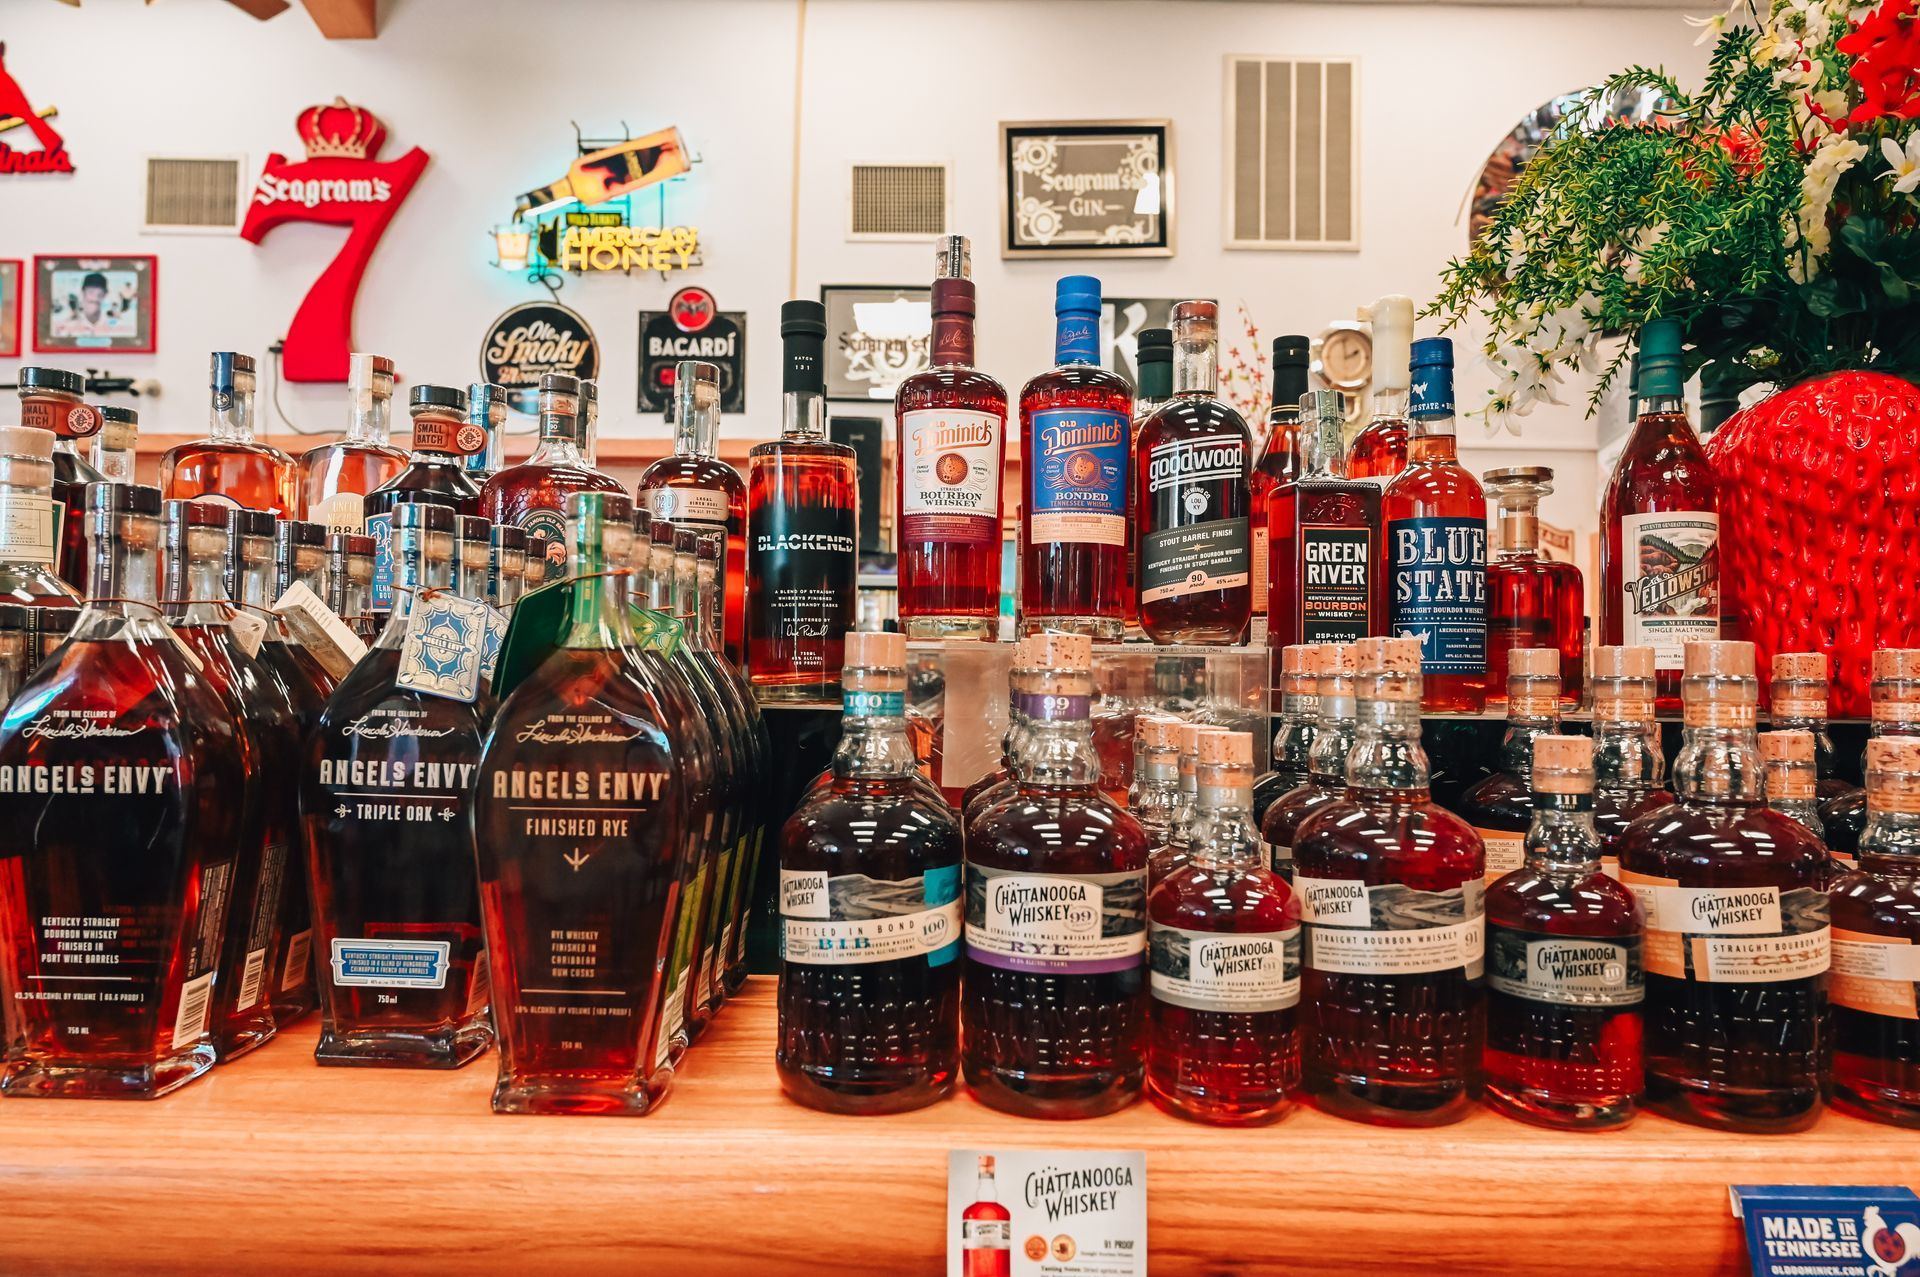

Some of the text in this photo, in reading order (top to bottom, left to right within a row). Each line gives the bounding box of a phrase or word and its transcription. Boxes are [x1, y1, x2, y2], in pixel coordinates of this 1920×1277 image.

[1041, 167, 1132, 196] Seagram's
[255, 174, 392, 207] Seagram's
[562, 226, 698, 250] AMERICAN
[240, 146, 430, 383] 7
[562, 246, 697, 271] HONEY
[487, 326, 591, 369] Smoky
[22, 404, 49, 415] SMALL
[1418, 402, 1439, 411] STATE
[417, 423, 443, 433] SMALL
[1060, 420, 1077, 428] OLD
[417, 434, 443, 444] BATCH
[1041, 419, 1122, 456] Dominick
[1149, 440, 1243, 492] goodwood
[920, 491, 982, 501] BOURBON
[1055, 492, 1109, 501] BONDED
[1181, 487, 1205, 500] BREWING
[925, 499, 977, 508] WHISKEY
[758, 533, 853, 553] BLACKENED
[1160, 528, 1233, 548] STOUT BARREL FINISH
[1305, 542, 1367, 563] GREEN
[1396, 527, 1485, 567] BLUE
[1148, 560, 1171, 570] KENTUCKY
[1172, 554, 1198, 563] STRAIGHT
[1200, 550, 1225, 559] BOURBON
[1159, 565, 1183, 574] FINISHED
[1192, 560, 1210, 568] STOUT
[1210, 556, 1233, 565] BARRELS
[1191, 574, 1203, 583] 90
[1307, 564, 1365, 585] RIVER
[1396, 570, 1485, 604] STATE
[1305, 601, 1367, 611] BOURBON
[1433, 606, 1463, 614] BOURBON
[849, 694, 882, 708] 100
[1043, 697, 1070, 711] 99
[1302, 695, 1320, 706] 91
[1373, 702, 1396, 714] 91
[53, 710, 117, 719] FROM THE CELLARS OF
[547, 715, 612, 723] FROM THE CELLARS OF
[0, 765, 168, 794] ANGELS ENVY
[319, 759, 474, 789] ANGELS ENVY
[493, 770, 662, 800] ANGELS ENVY
[1219, 787, 1237, 799] 91
[1555, 794, 1578, 806] 111
[356, 804, 432, 821] TRIPLE OAK
[526, 818, 628, 837] FINISHED RYE
[786, 892, 816, 909] WHISKEY
[1009, 902, 1070, 927] WHISKEY
[1312, 900, 1352, 918] WHISKEY
[42, 917, 120, 927] KENTUCKY STRAIGHT
[1069, 911, 1092, 923] 99
[1707, 907, 1763, 929] WHISKEY
[44, 929, 117, 939] BOURBON WHISKEY
[788, 920, 915, 937] BOTTLED IN BOND
[922, 918, 946, 936] 100
[551, 930, 598, 940] RYE WHISKEY
[1315, 931, 1458, 945] STRAIGHT BOURBON WHISKEY
[1464, 931, 1479, 947] 91
[57, 942, 103, 951] FINISHED IN
[551, 943, 597, 952] FINISHED IN
[1010, 941, 1072, 957] RYE
[1713, 938, 1815, 953] STRAIGHT BOURBON
[41, 954, 119, 964] PORT WINE BARRELS
[551, 956, 597, 965] CARIBBEAN
[552, 968, 595, 977] RUM CASKS
[1213, 957, 1263, 978] WHISKEY
[1551, 960, 1605, 981] WHISKEY
[35, 992, 62, 1000] ALCOHOL
[530, 1006, 556, 1014] ALCOHOL
[558, 1006, 566, 1014] BY
[567, 1007, 591, 1015] VOLUME
[1045, 1190, 1118, 1223] WHISKEY
[1762, 1216, 1857, 1240] MADE IN
[1115, 1240, 1135, 1249] PROOF
[1764, 1241, 1863, 1258] TENNESSEE
